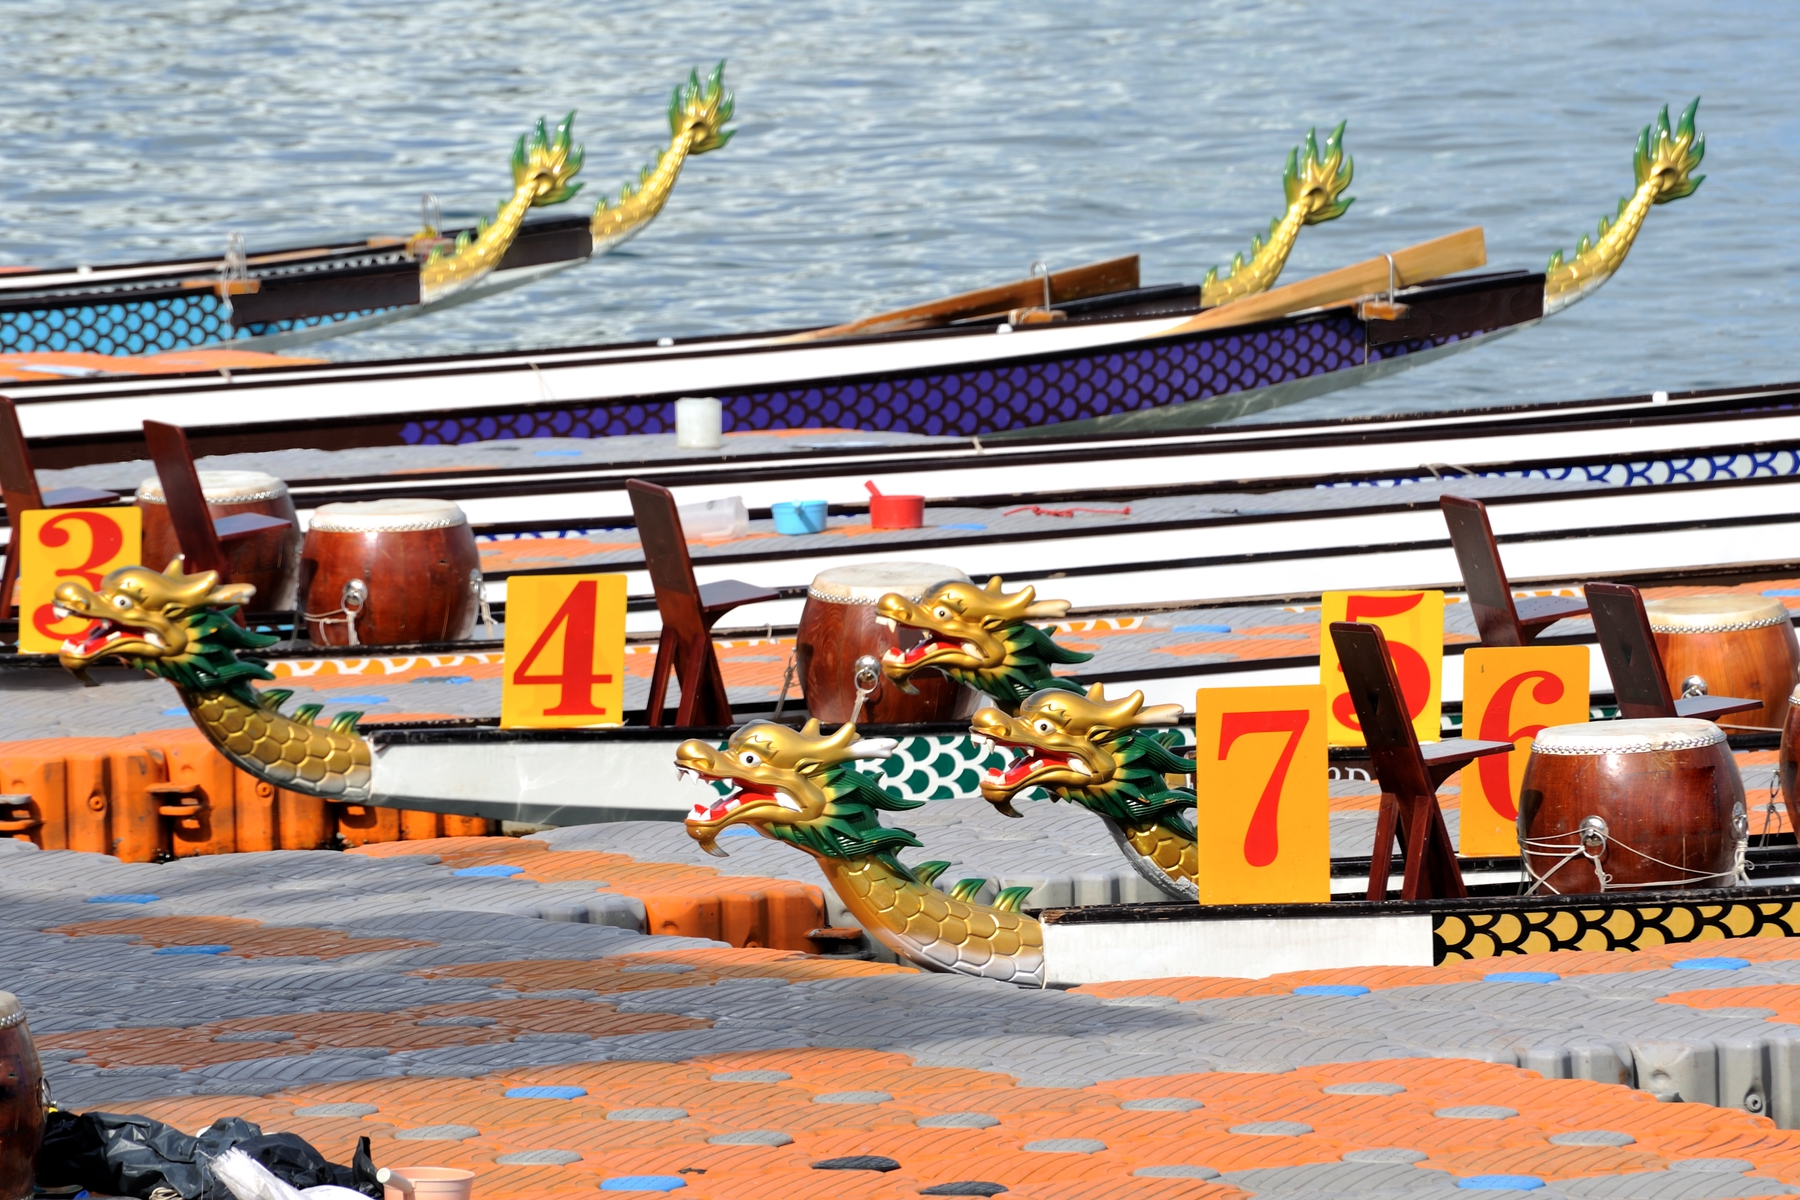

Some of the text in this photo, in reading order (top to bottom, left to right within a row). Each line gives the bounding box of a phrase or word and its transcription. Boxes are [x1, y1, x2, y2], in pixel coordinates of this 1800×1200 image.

[38, 511, 123, 642] 3
[513, 580, 612, 716] 4
[1332, 592, 1431, 732] 5
[1218, 709, 1310, 868] 7
[1478, 670, 1565, 823] 6
